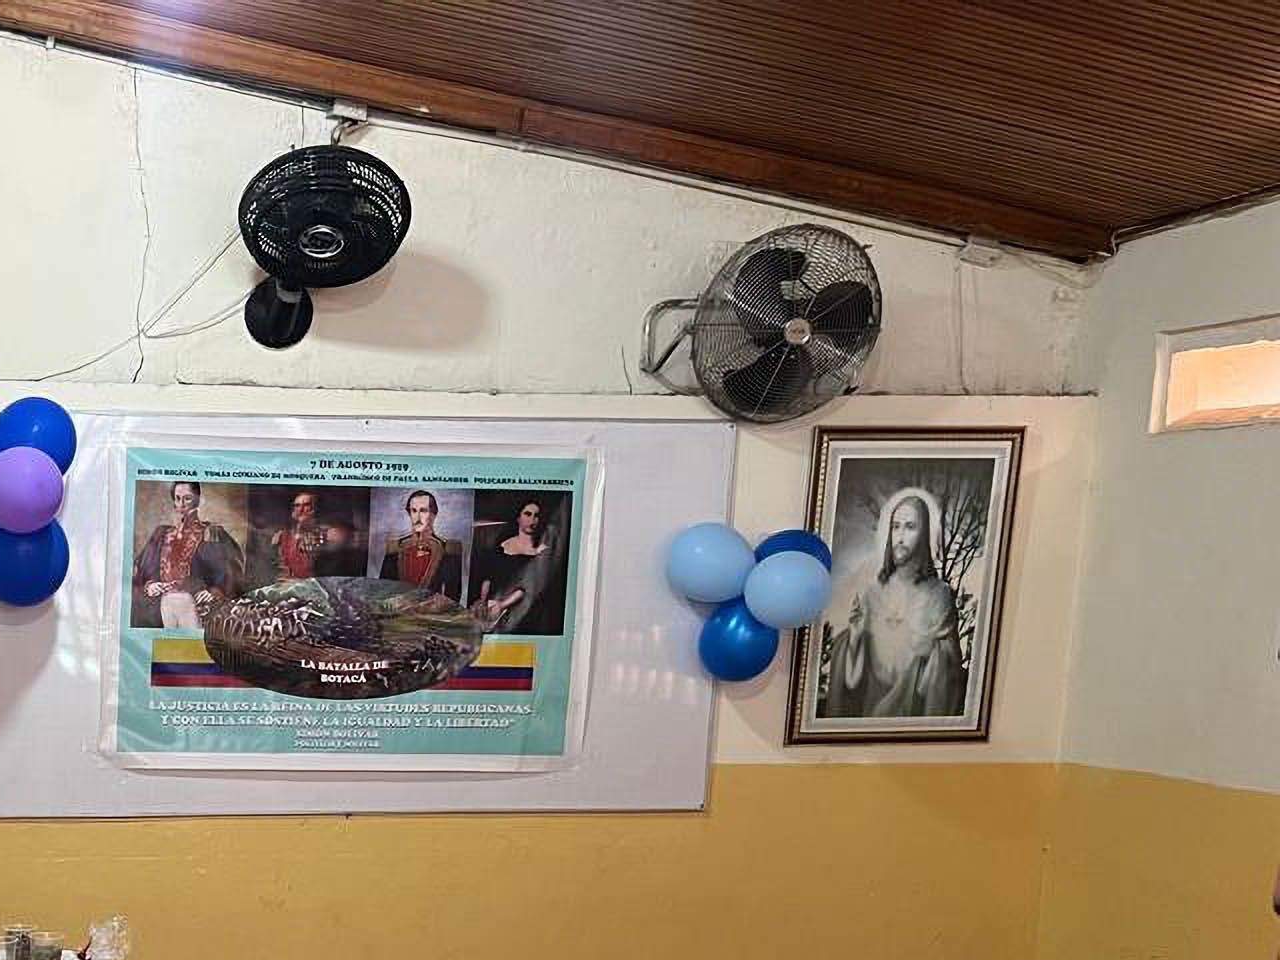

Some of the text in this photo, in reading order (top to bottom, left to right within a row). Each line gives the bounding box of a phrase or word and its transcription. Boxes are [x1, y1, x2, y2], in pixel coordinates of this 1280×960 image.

[320, 460, 335, 469] DE
[336, 460, 383, 470] AGOSTO
[301, 659, 388, 671] LA BATALLA DE
[149, 701, 166, 711] LA
[167, 701, 229, 712] JUSTICIA
[232, 702, 250, 712] ES
[363, 704, 431, 714] VIRTUDES
[172, 715, 200, 725] CON
[323, 717, 340, 727] LA
[343, 717, 411, 727] IGUALDAD
[426, 718, 444, 727] LA
